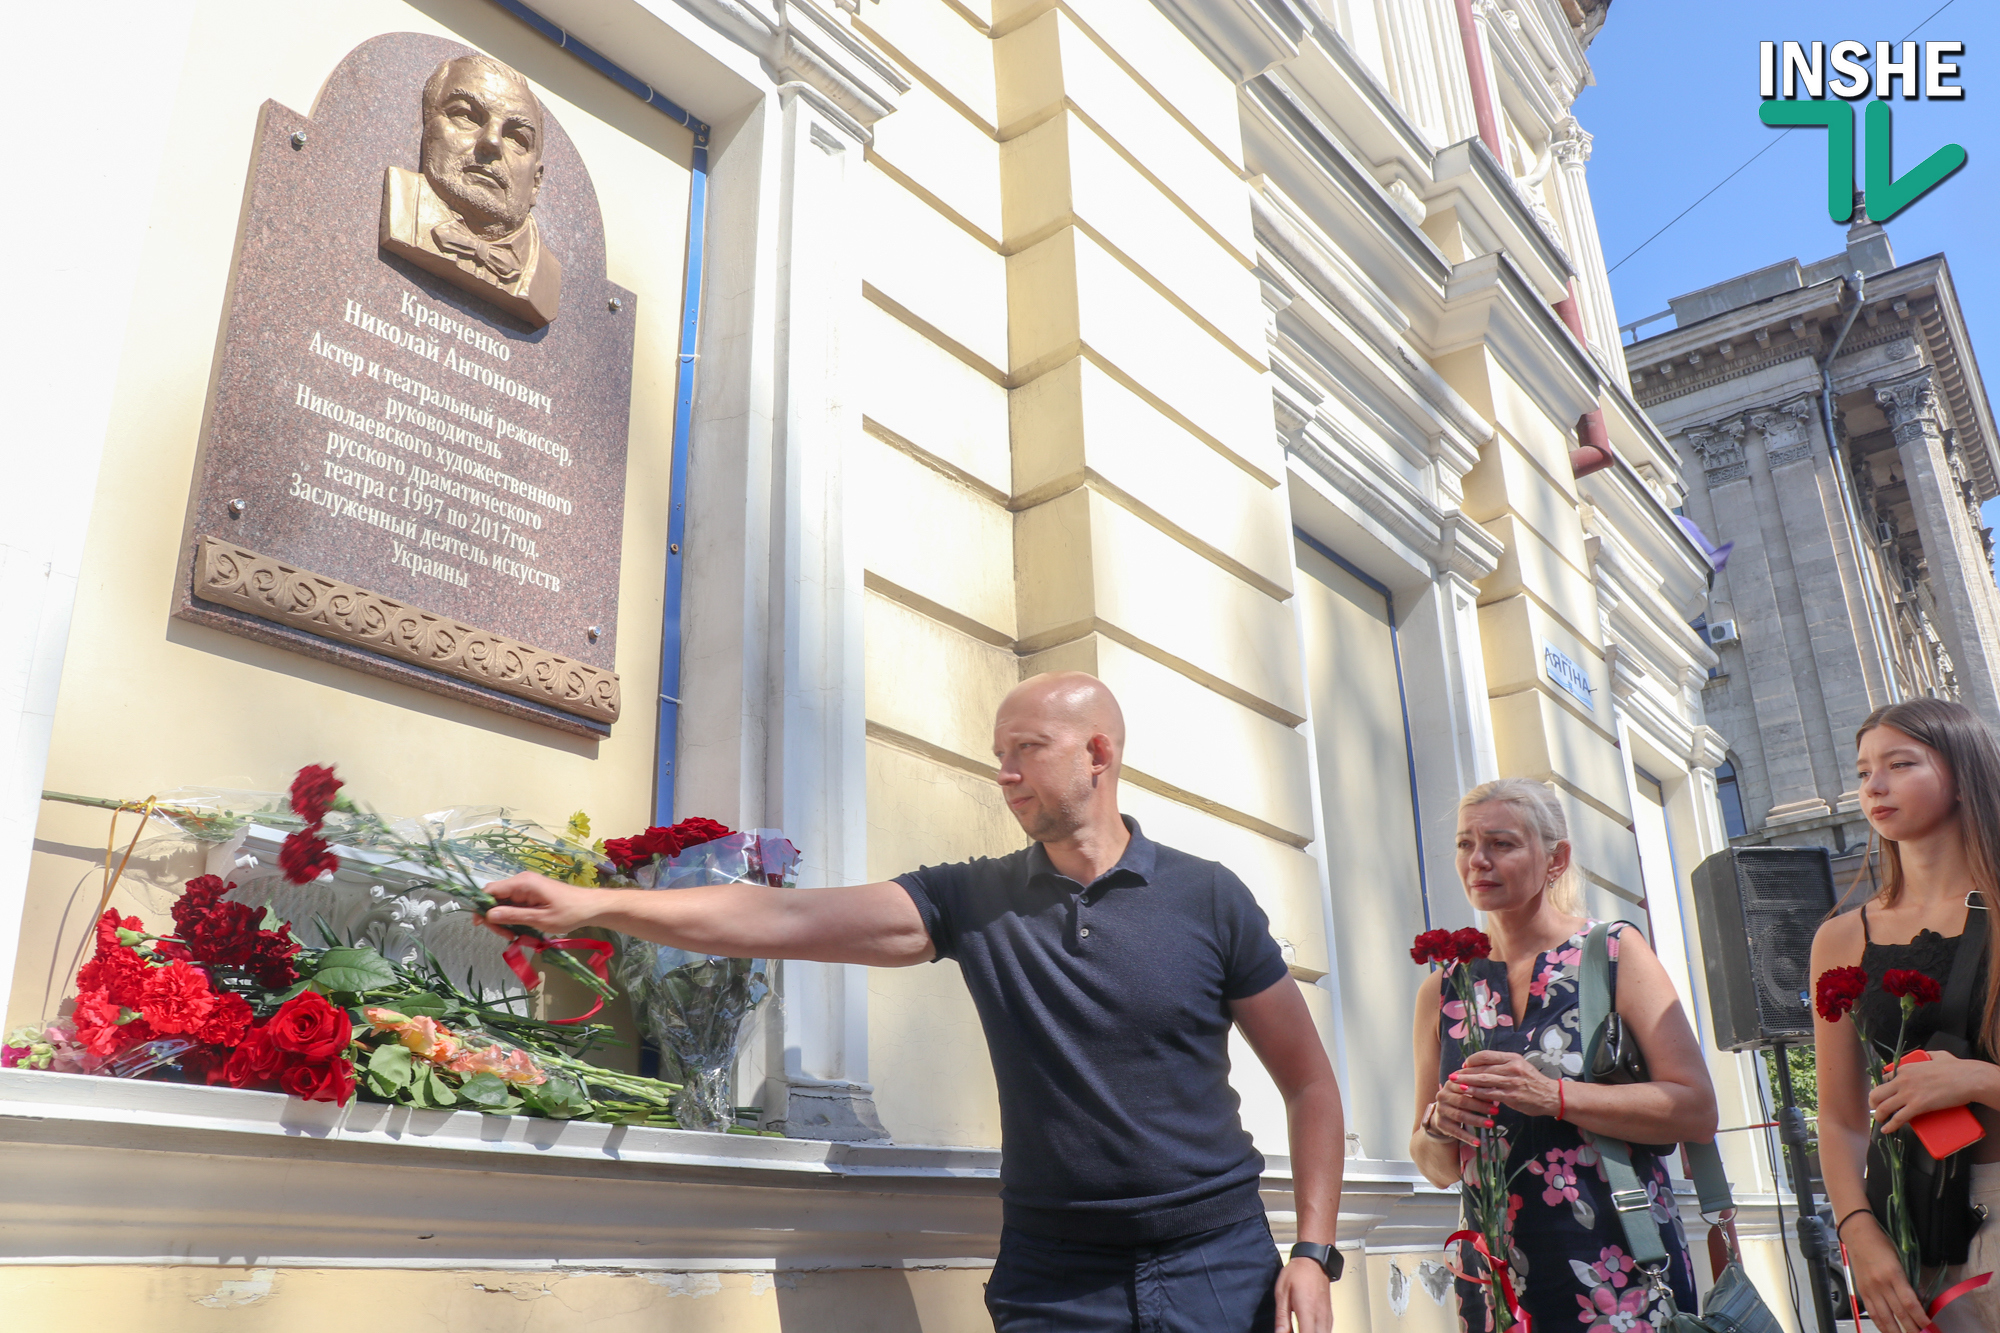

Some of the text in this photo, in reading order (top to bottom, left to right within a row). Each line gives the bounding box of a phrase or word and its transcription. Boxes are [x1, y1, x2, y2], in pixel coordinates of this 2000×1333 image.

[344, 298, 552, 414] Николай Антонович
[400, 290, 510, 362] Кравченко
[308, 329, 573, 468] Актер и театральный режиссер,
[385, 397, 502, 460] руководитель
[295, 382, 572, 516] Николаевского художественного
[326, 431, 542, 531] русского драматического
[289, 472, 561, 593] Заслуженный деятель искусств
[323, 460, 540, 560] театра с 1997 по 2017год.
[391, 541, 469, 589] Украины
